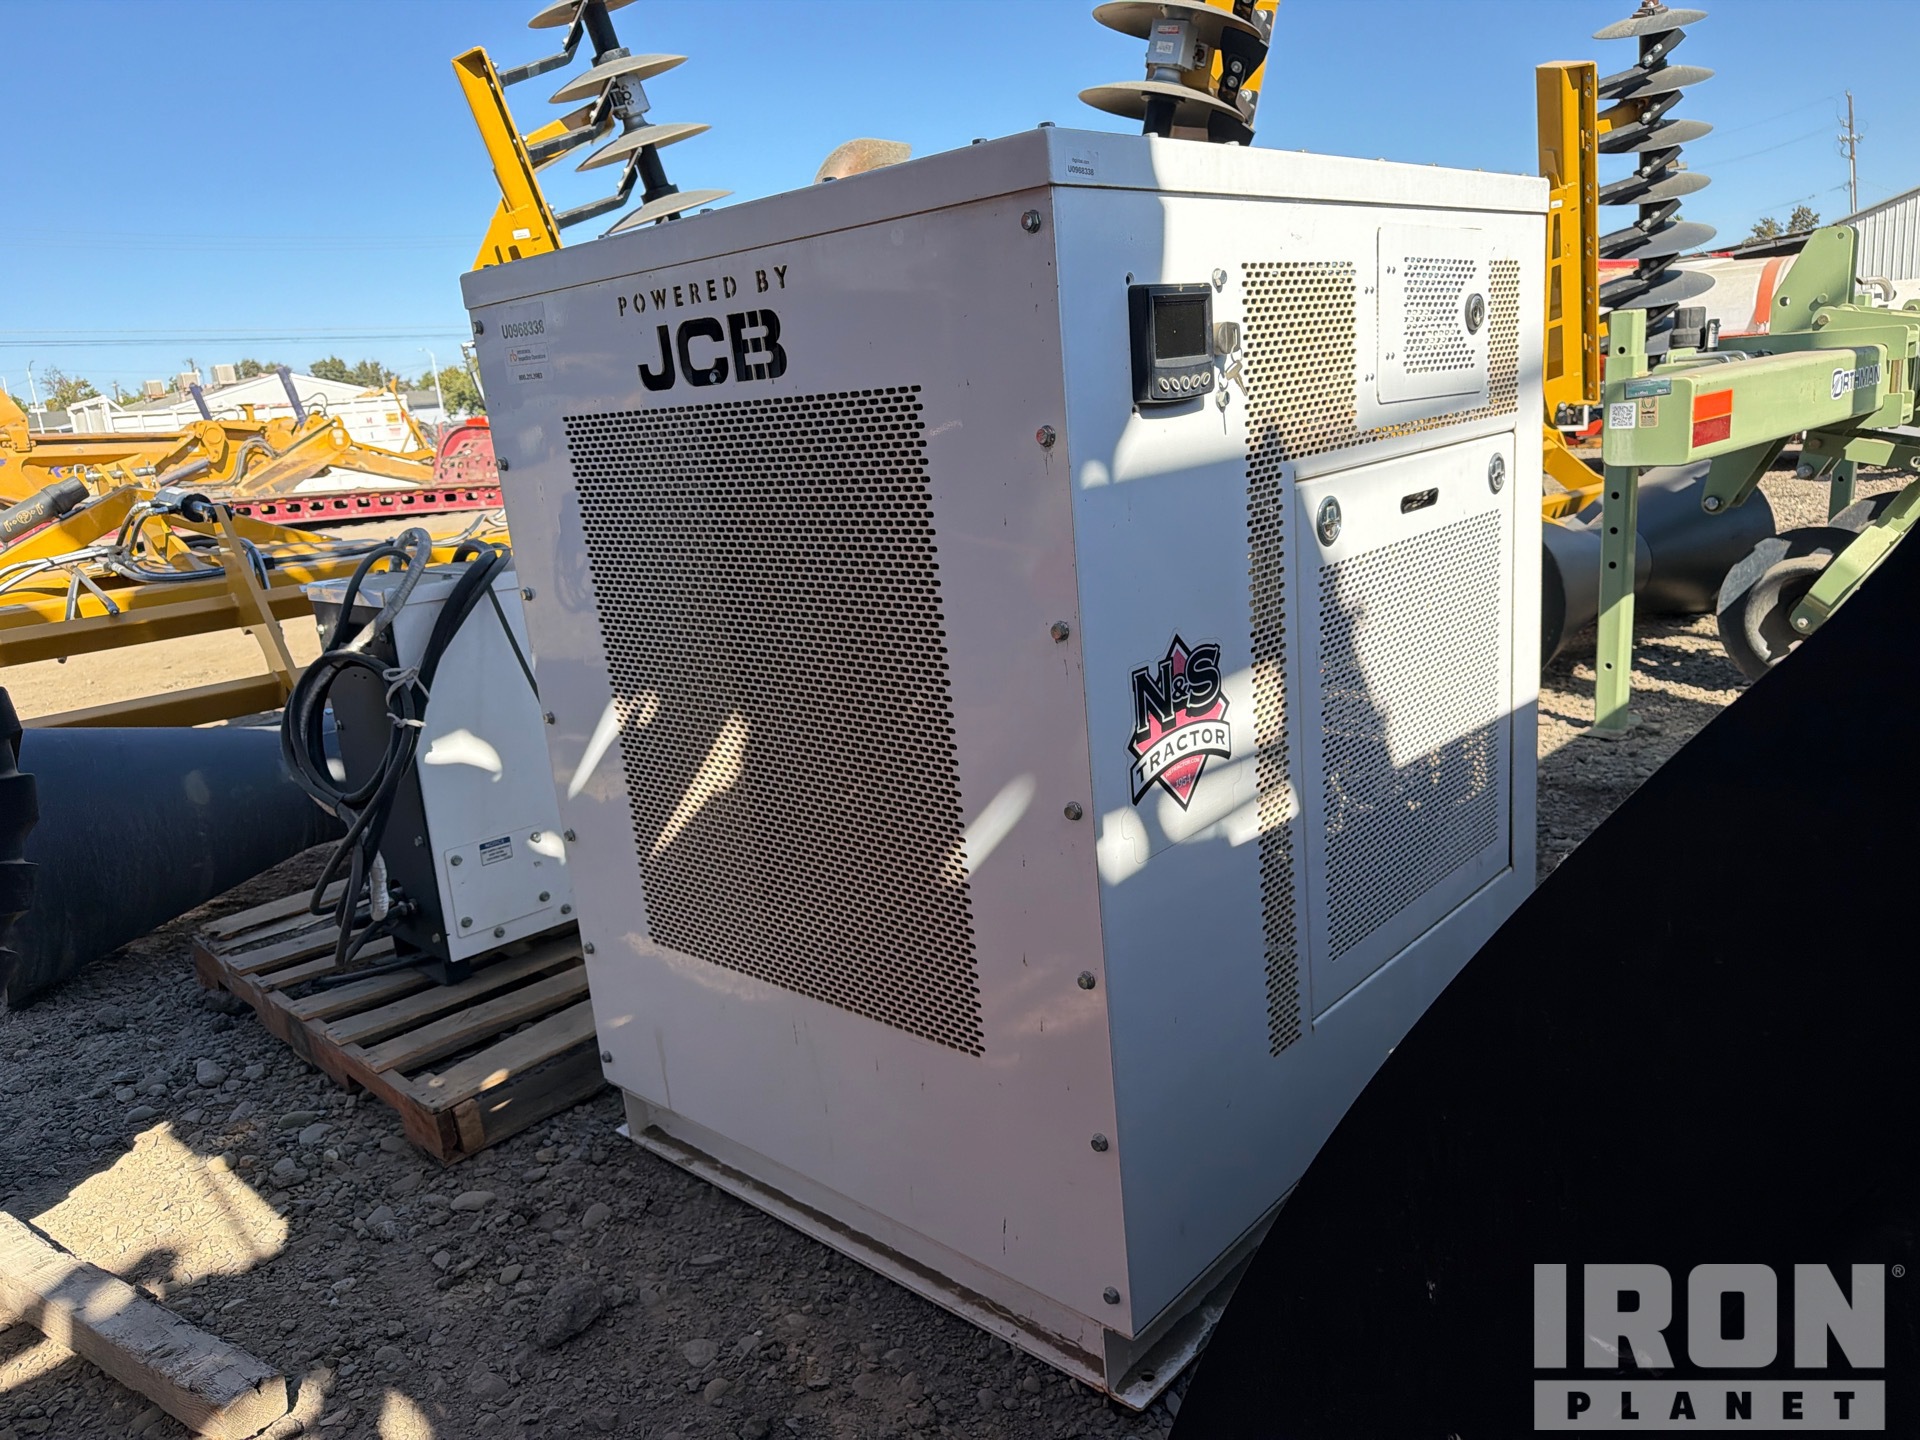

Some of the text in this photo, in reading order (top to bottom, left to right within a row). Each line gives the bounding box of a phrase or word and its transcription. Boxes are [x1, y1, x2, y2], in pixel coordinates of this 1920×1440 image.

[618, 265, 788, 316] POWERED BY
[501, 319, 545, 339] U0968338
[637, 308, 788, 391] JCB
[1132, 643, 1221, 744] N&S
[1135, 728, 1226, 784] TRACTOR
